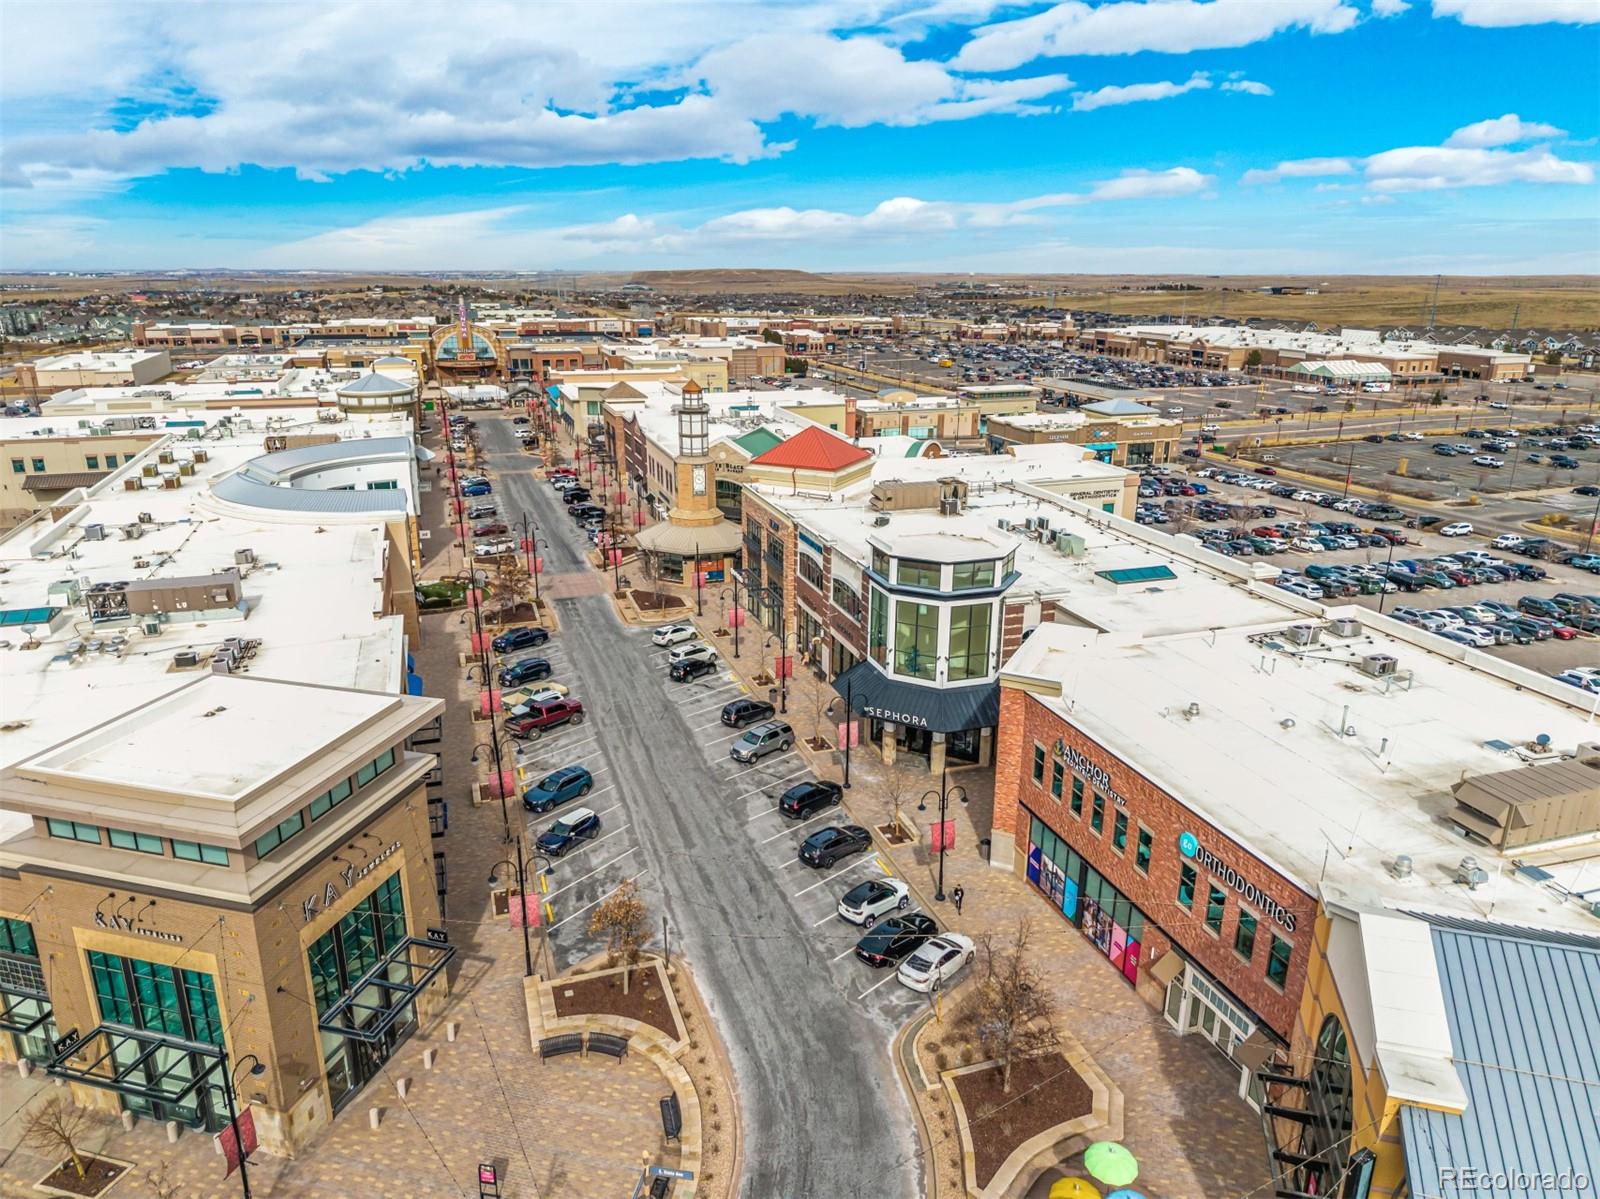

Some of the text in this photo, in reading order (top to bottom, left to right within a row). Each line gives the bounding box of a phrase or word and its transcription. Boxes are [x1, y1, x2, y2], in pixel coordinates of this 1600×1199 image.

[868, 706, 928, 727] SEPHORA
[1063, 744, 1111, 788] ANCHOR
[1092, 777, 1127, 807] DENTISTRY
[302, 863, 355, 922] KAY
[1195, 845, 1296, 932] ORTHODONTICS
[427, 931, 445, 942] KAY
